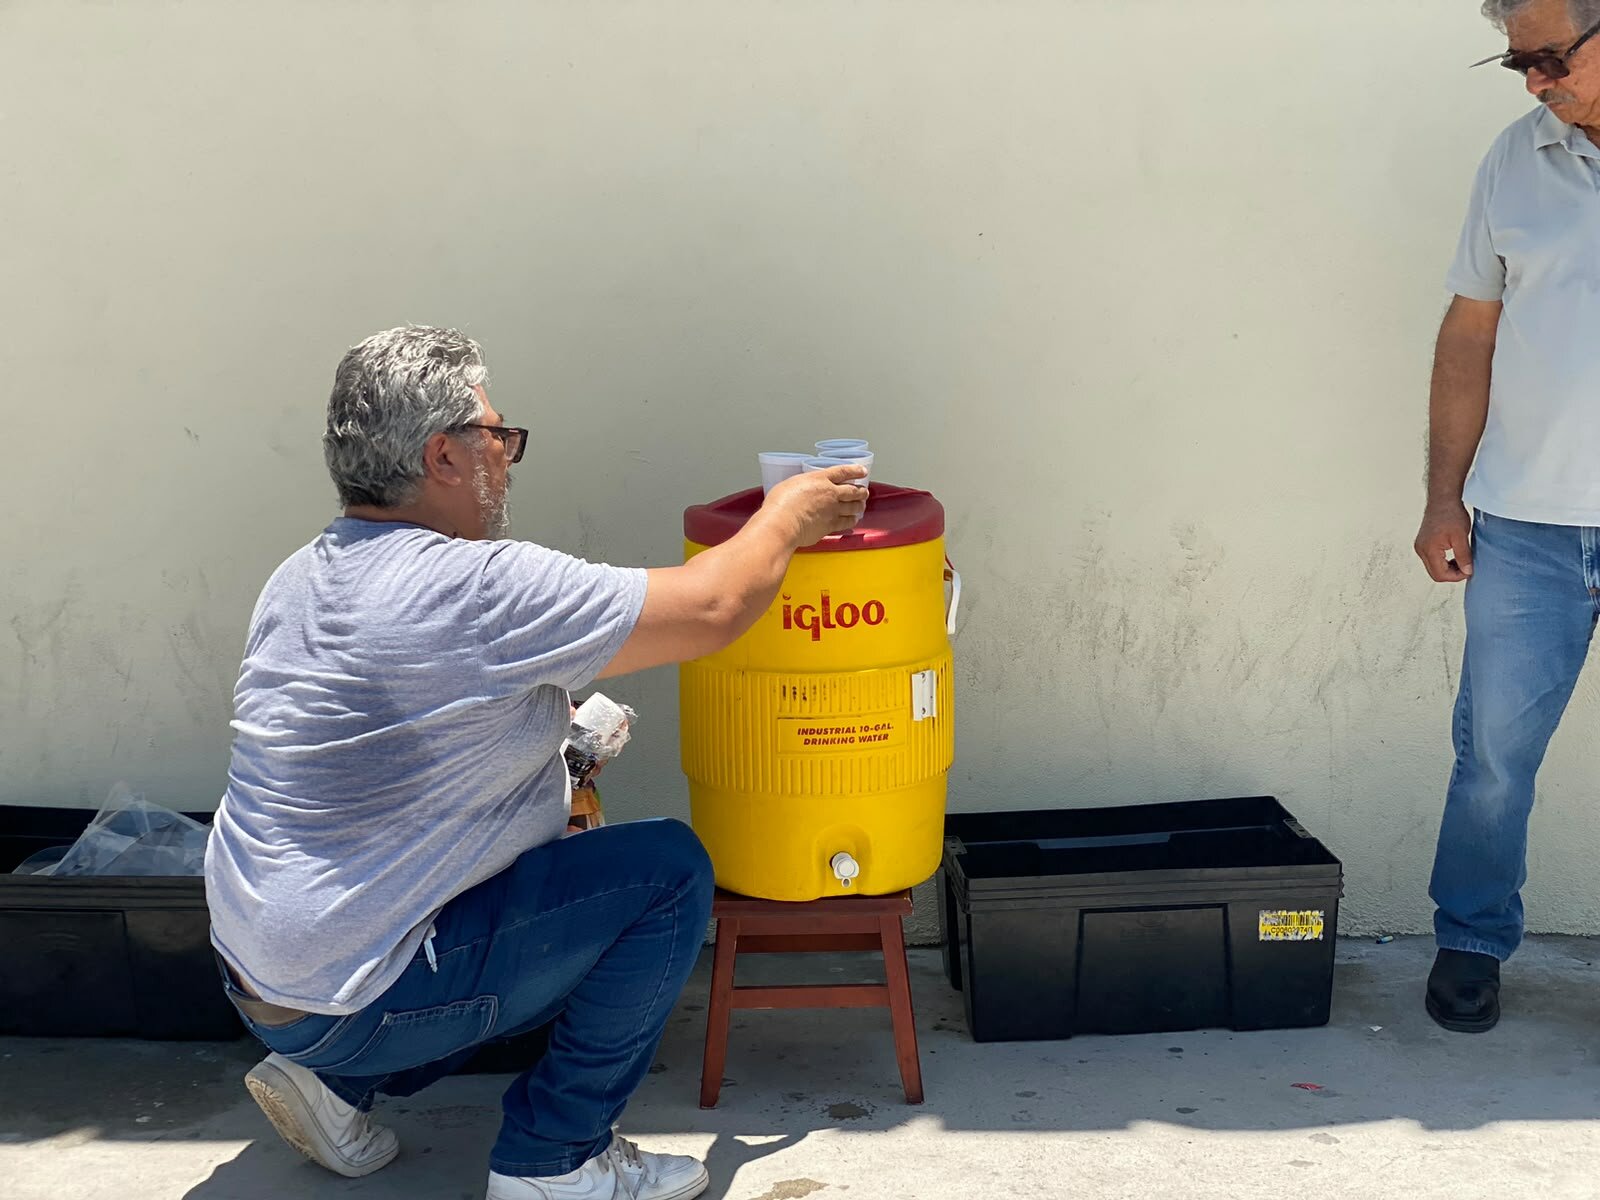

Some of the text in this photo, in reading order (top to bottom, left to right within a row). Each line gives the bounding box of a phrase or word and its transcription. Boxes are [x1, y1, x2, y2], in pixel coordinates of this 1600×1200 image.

[782, 589, 885, 641] igloo
[797, 722, 894, 736] INDUSTRIAL 10-GAL.
[803, 733, 889, 746] DRINKING WATER
